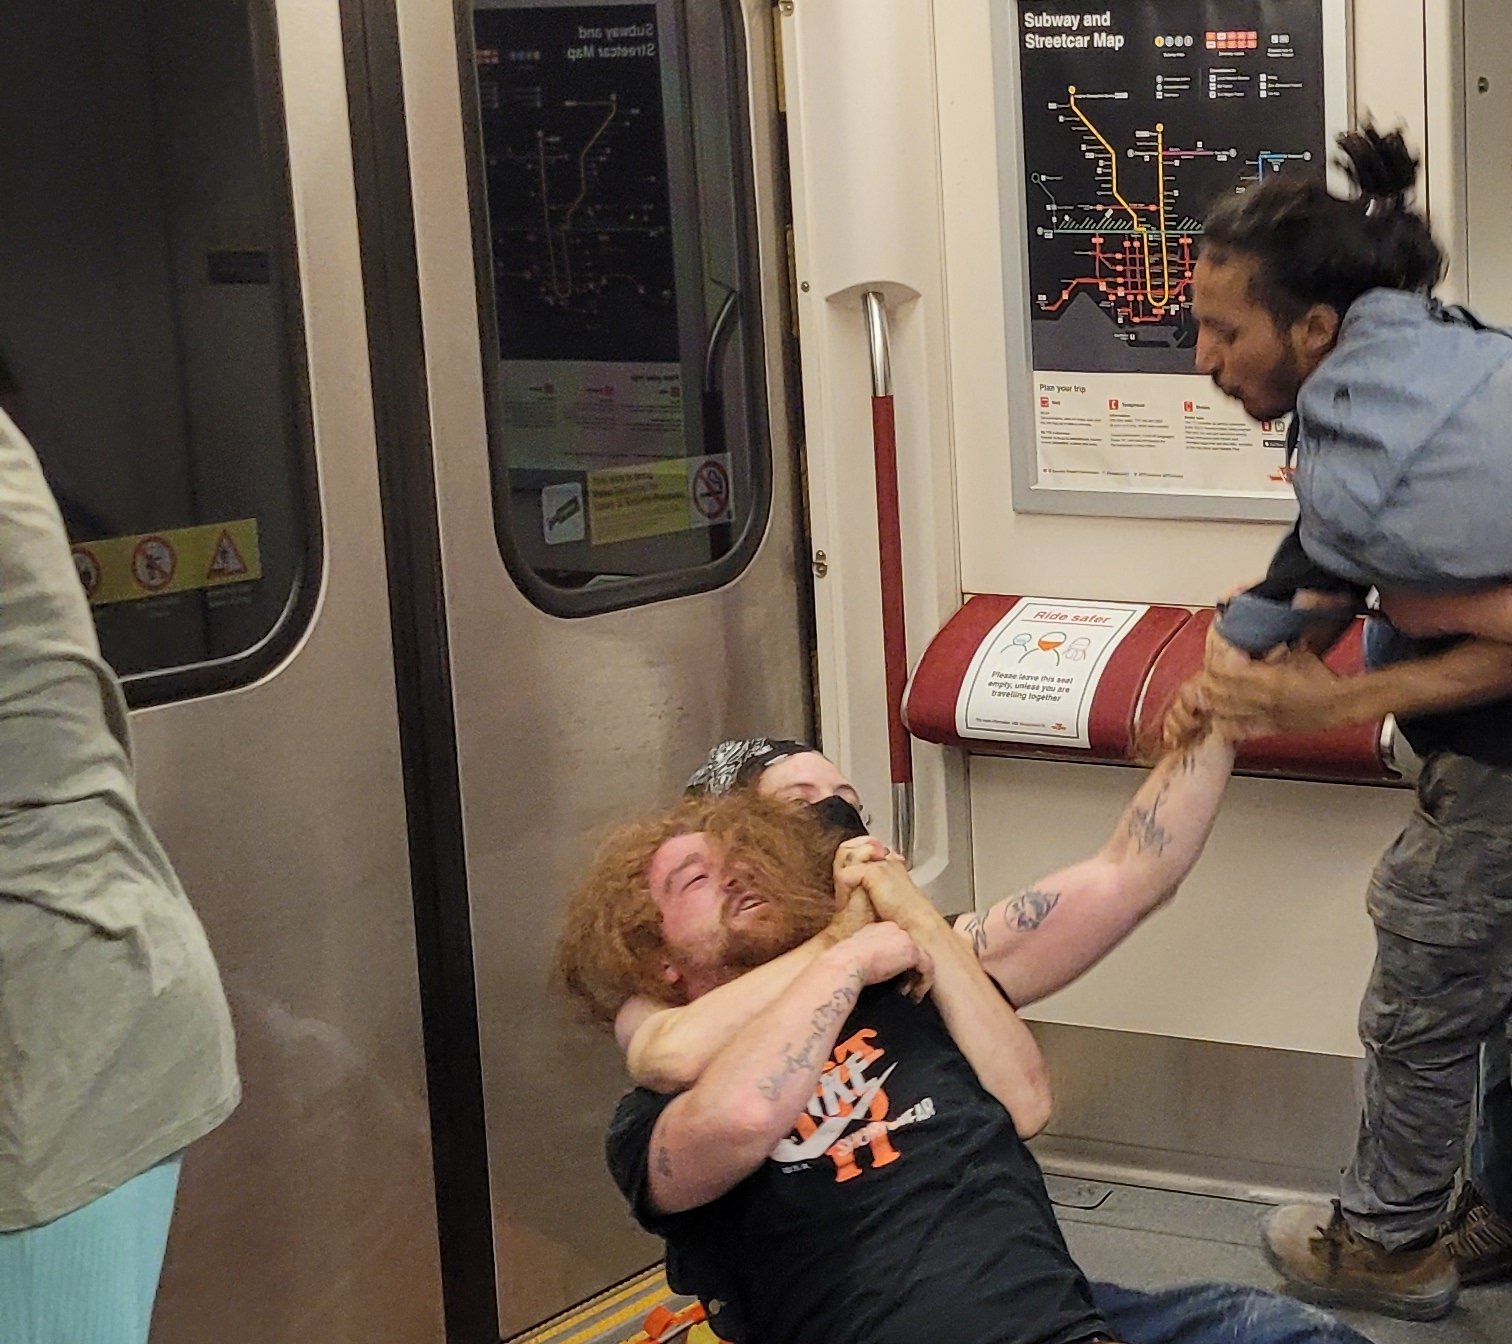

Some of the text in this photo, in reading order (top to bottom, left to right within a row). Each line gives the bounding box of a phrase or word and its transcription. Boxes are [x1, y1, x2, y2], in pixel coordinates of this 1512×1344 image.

[1024, 10, 1111, 30] Subway and
[1024, 32, 1125, 51] Streetcar Map
[1039, 383, 1086, 394] Plan your trip
[1033, 611, 1111, 624] Ride safer
[991, 670, 1073, 684] Please leave this seat
[1015, 682, 1040, 691] unless
[1041, 684, 1055, 692] you
[991, 690, 1061, 702] travelling together
